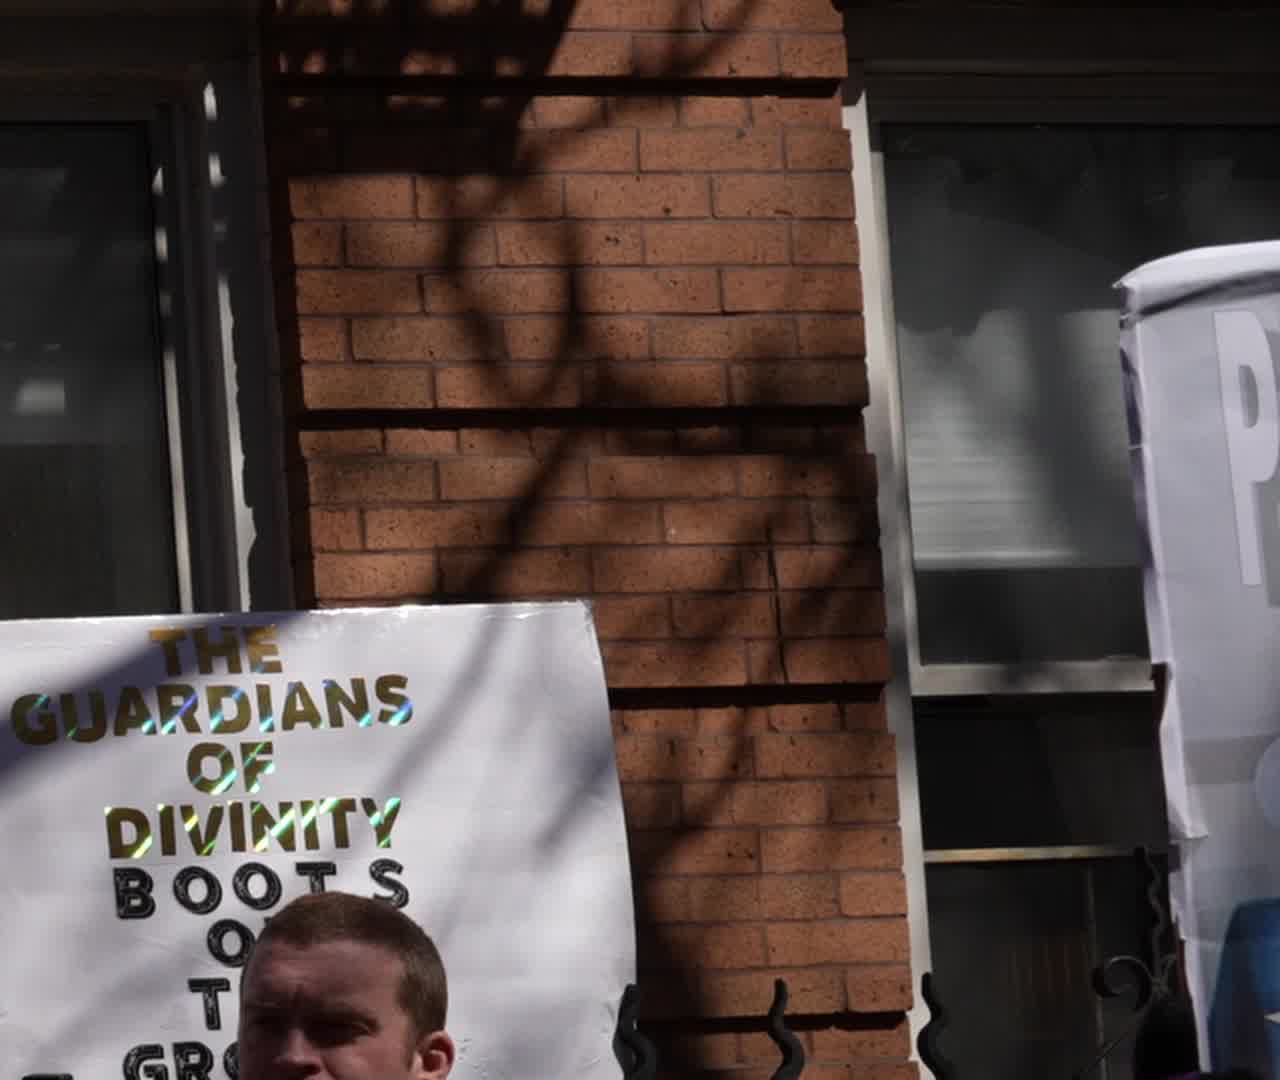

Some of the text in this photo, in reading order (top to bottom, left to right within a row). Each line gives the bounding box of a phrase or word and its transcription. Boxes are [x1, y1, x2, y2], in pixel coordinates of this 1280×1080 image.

[1214, 310, 1280, 585] P
[148, 624, 283, 676] THE
[10, 673, 414, 746] GUARDIANS
[185, 740, 276, 795] OF
[104, 797, 401, 860] DIVINITY
[206, 917, 272, 968] O
[187, 977, 231, 1031] T
